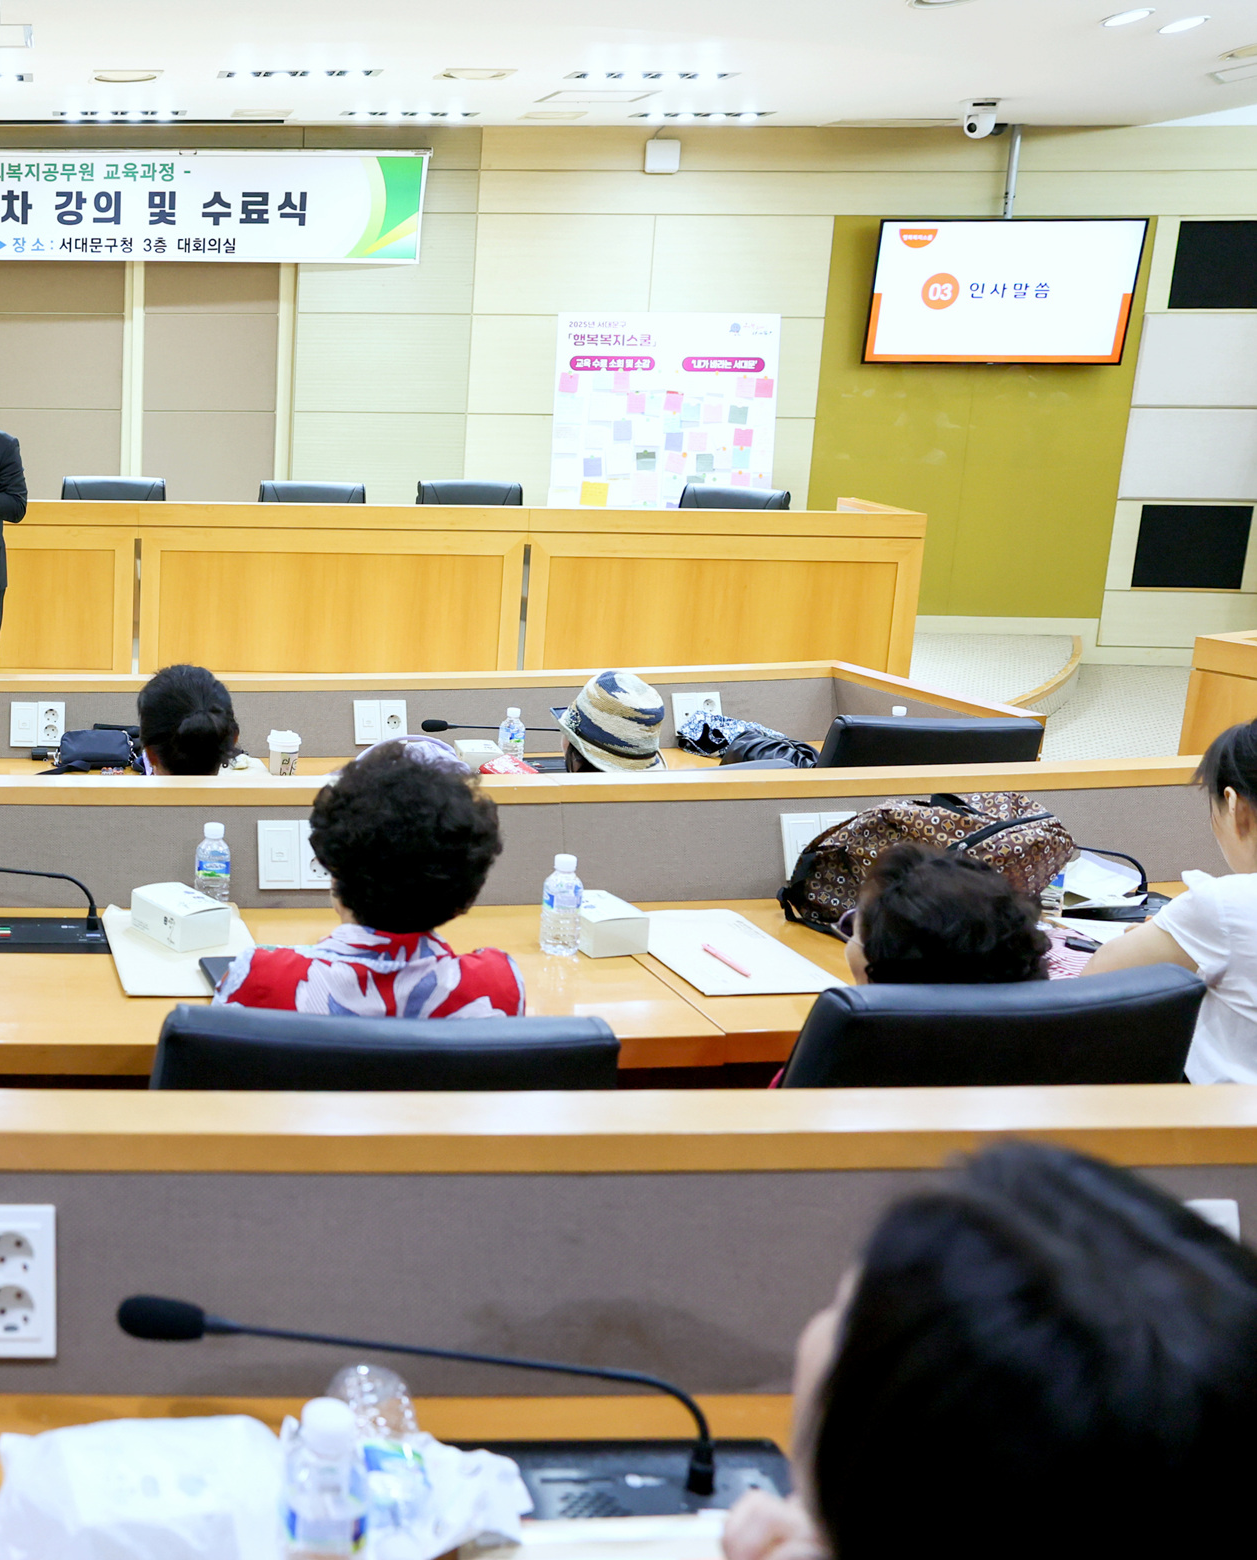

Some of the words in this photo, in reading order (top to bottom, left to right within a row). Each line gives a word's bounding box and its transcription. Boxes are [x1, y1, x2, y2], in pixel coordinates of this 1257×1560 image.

[103, 162, 175, 183] 교육과정
[55, 191, 122, 226] 강의
[148, 191, 177, 226] 및
[202, 191, 308, 227] 수료식
[58, 237, 133, 254] 서대문구청
[143, 237, 168, 253] 3층
[177, 237, 236, 254] 대회의실
[928, 283, 953, 301] 03
